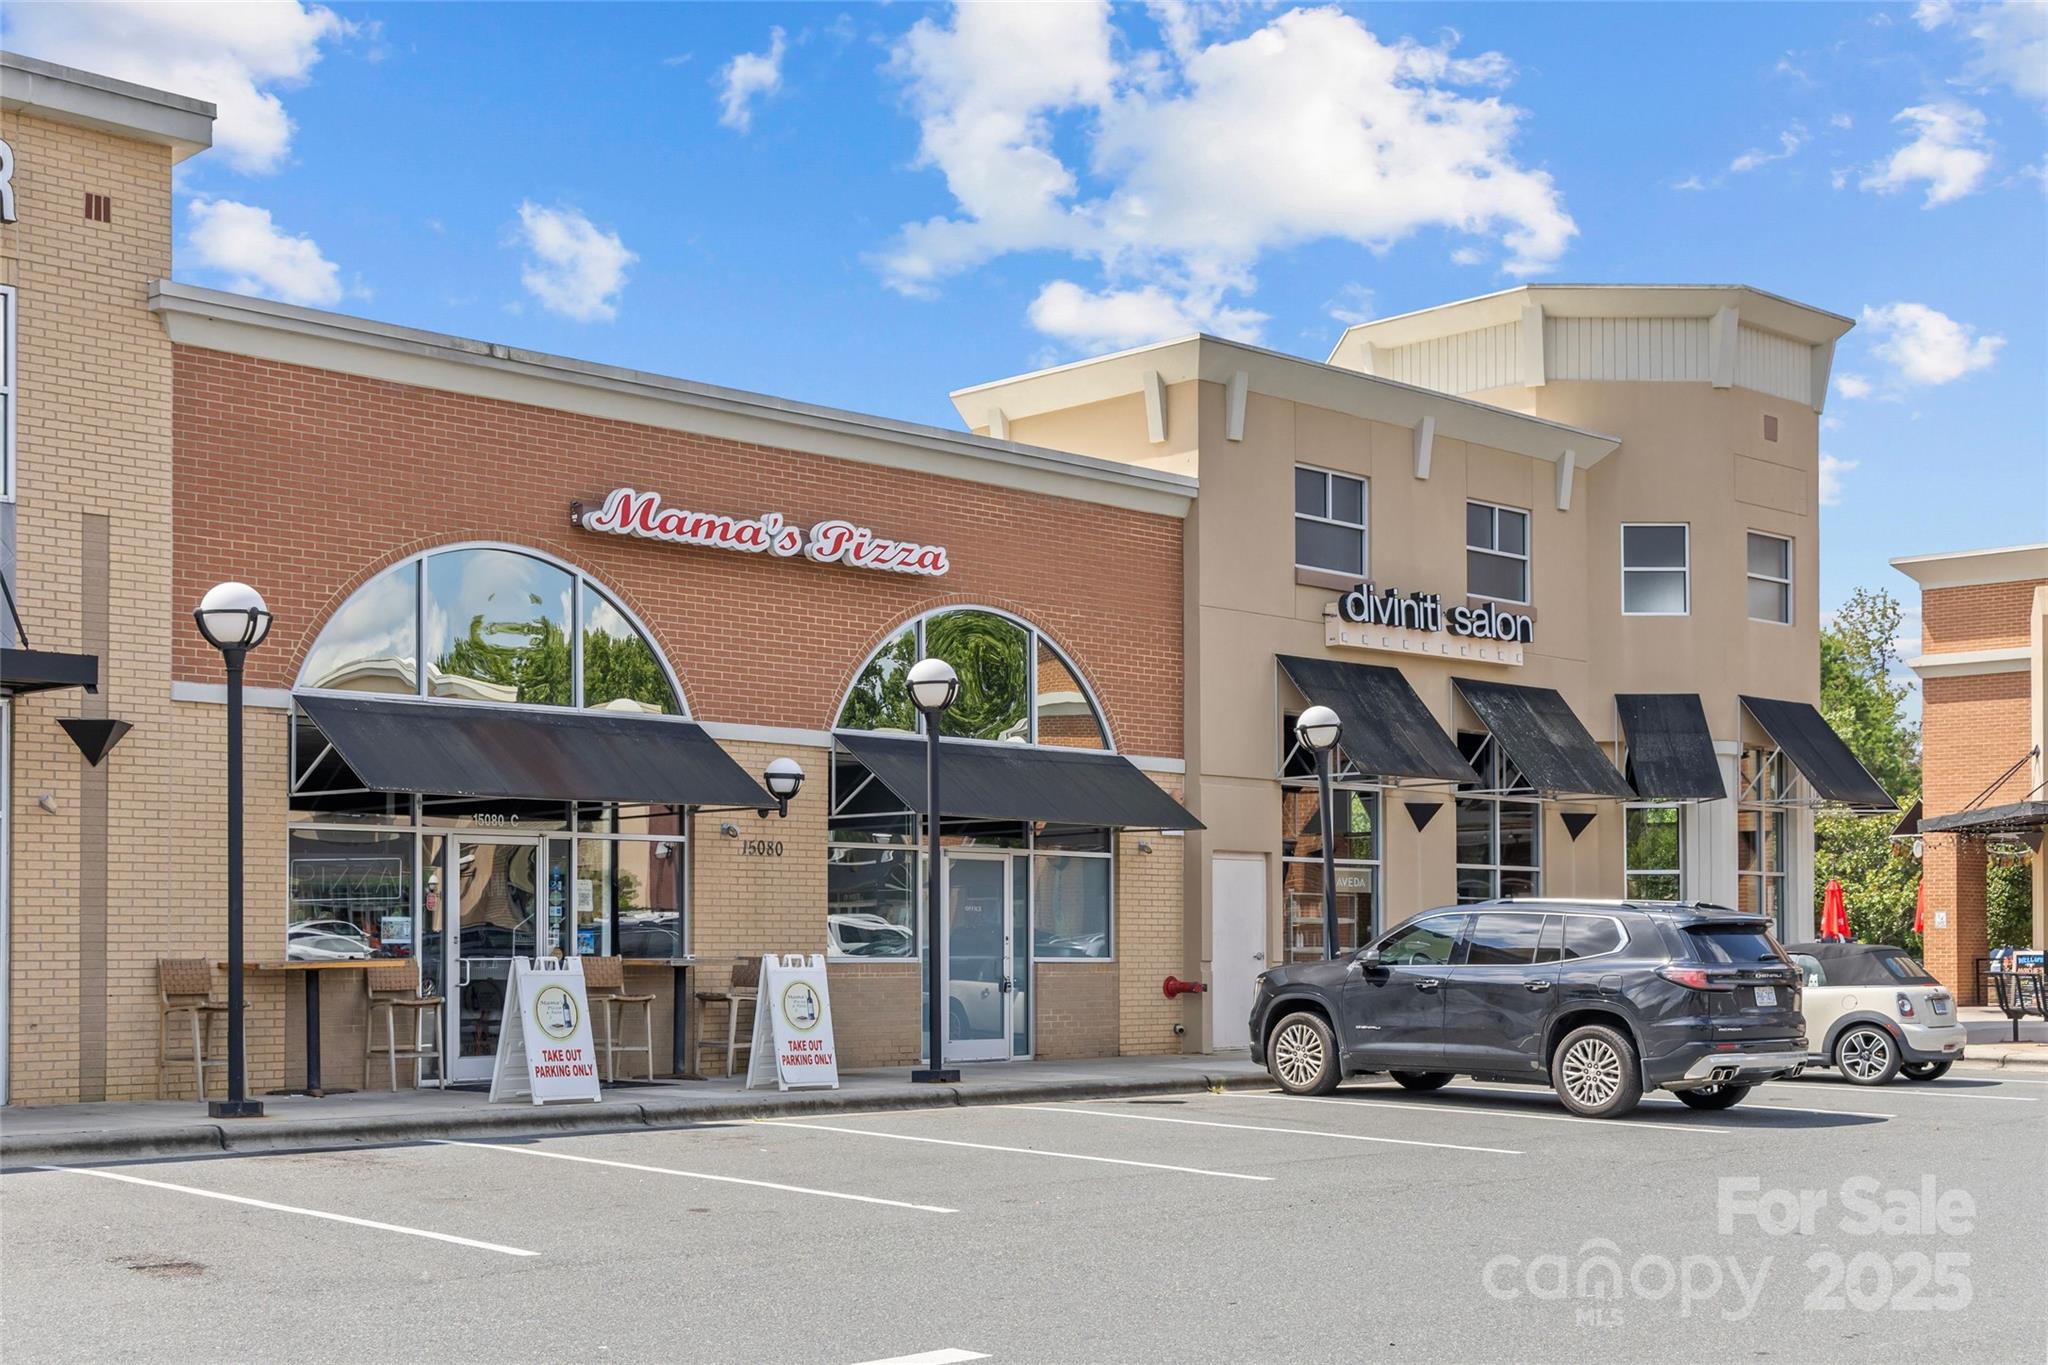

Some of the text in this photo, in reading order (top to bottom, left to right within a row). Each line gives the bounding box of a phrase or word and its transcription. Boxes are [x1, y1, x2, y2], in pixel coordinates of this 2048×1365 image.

[588, 489, 948, 575] Mama's Pizza
[1342, 584, 1534, 643] diviniti salon
[473, 813, 519, 828] 15080 C
[743, 840, 783, 857] 15080
[296, 864, 399, 895] PIZZA
[1336, 876, 1367, 888] AVEDA
[788, 1040, 823, 1052] TAKE OUT
[542, 1049, 582, 1062] TAKE OUT
[781, 1054, 832, 1066] PARKING ONLY
[535, 1063, 593, 1078] PARKING ONLY
